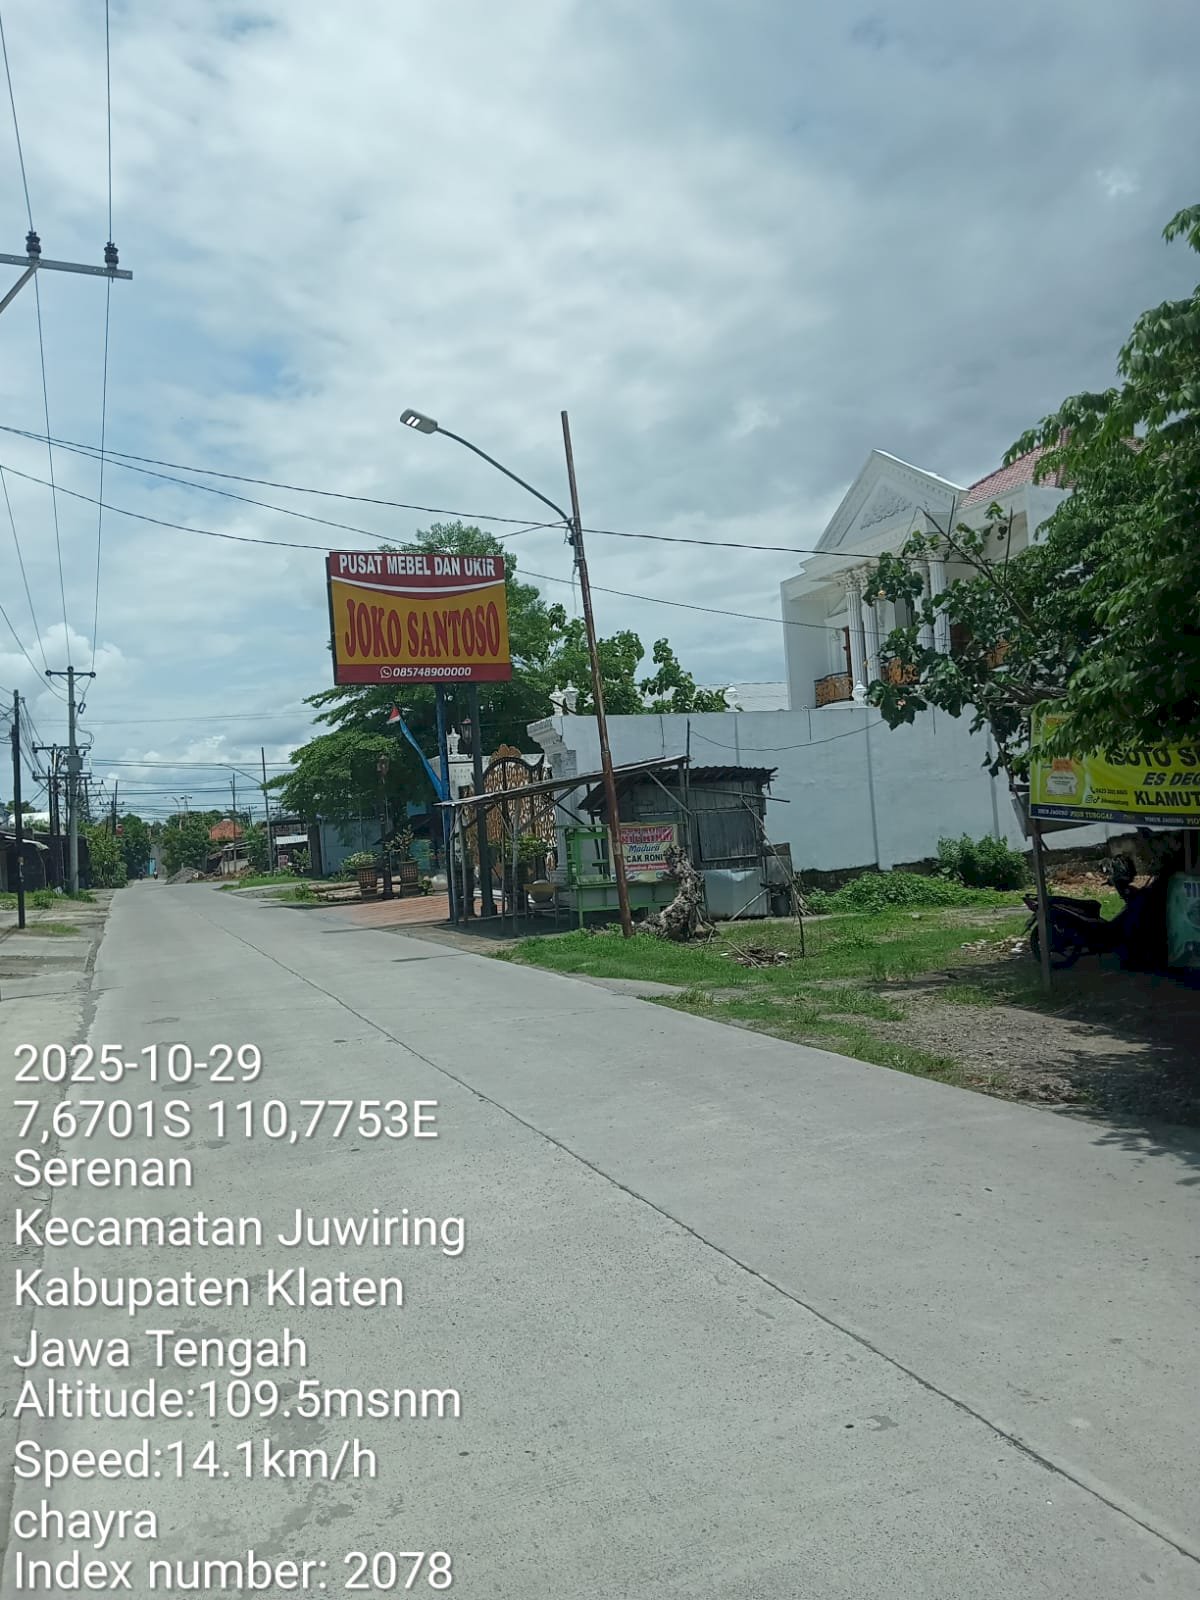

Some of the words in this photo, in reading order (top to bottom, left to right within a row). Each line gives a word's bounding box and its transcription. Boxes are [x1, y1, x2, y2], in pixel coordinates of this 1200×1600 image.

[339, 554, 383, 575] PUSAT
[386, 555, 431, 576] MEBEL
[434, 556, 461, 577] DAN
[463, 557, 496, 577] UKIR
[345, 599, 402, 658] JOKO
[407, 601, 500, 657] SANTOSO
[393, 667, 471, 678] 085748900000
[1178, 747, 1200, 767] S
[1143, 772, 1167, 785] ES
[629, 844, 660, 853] Madura
